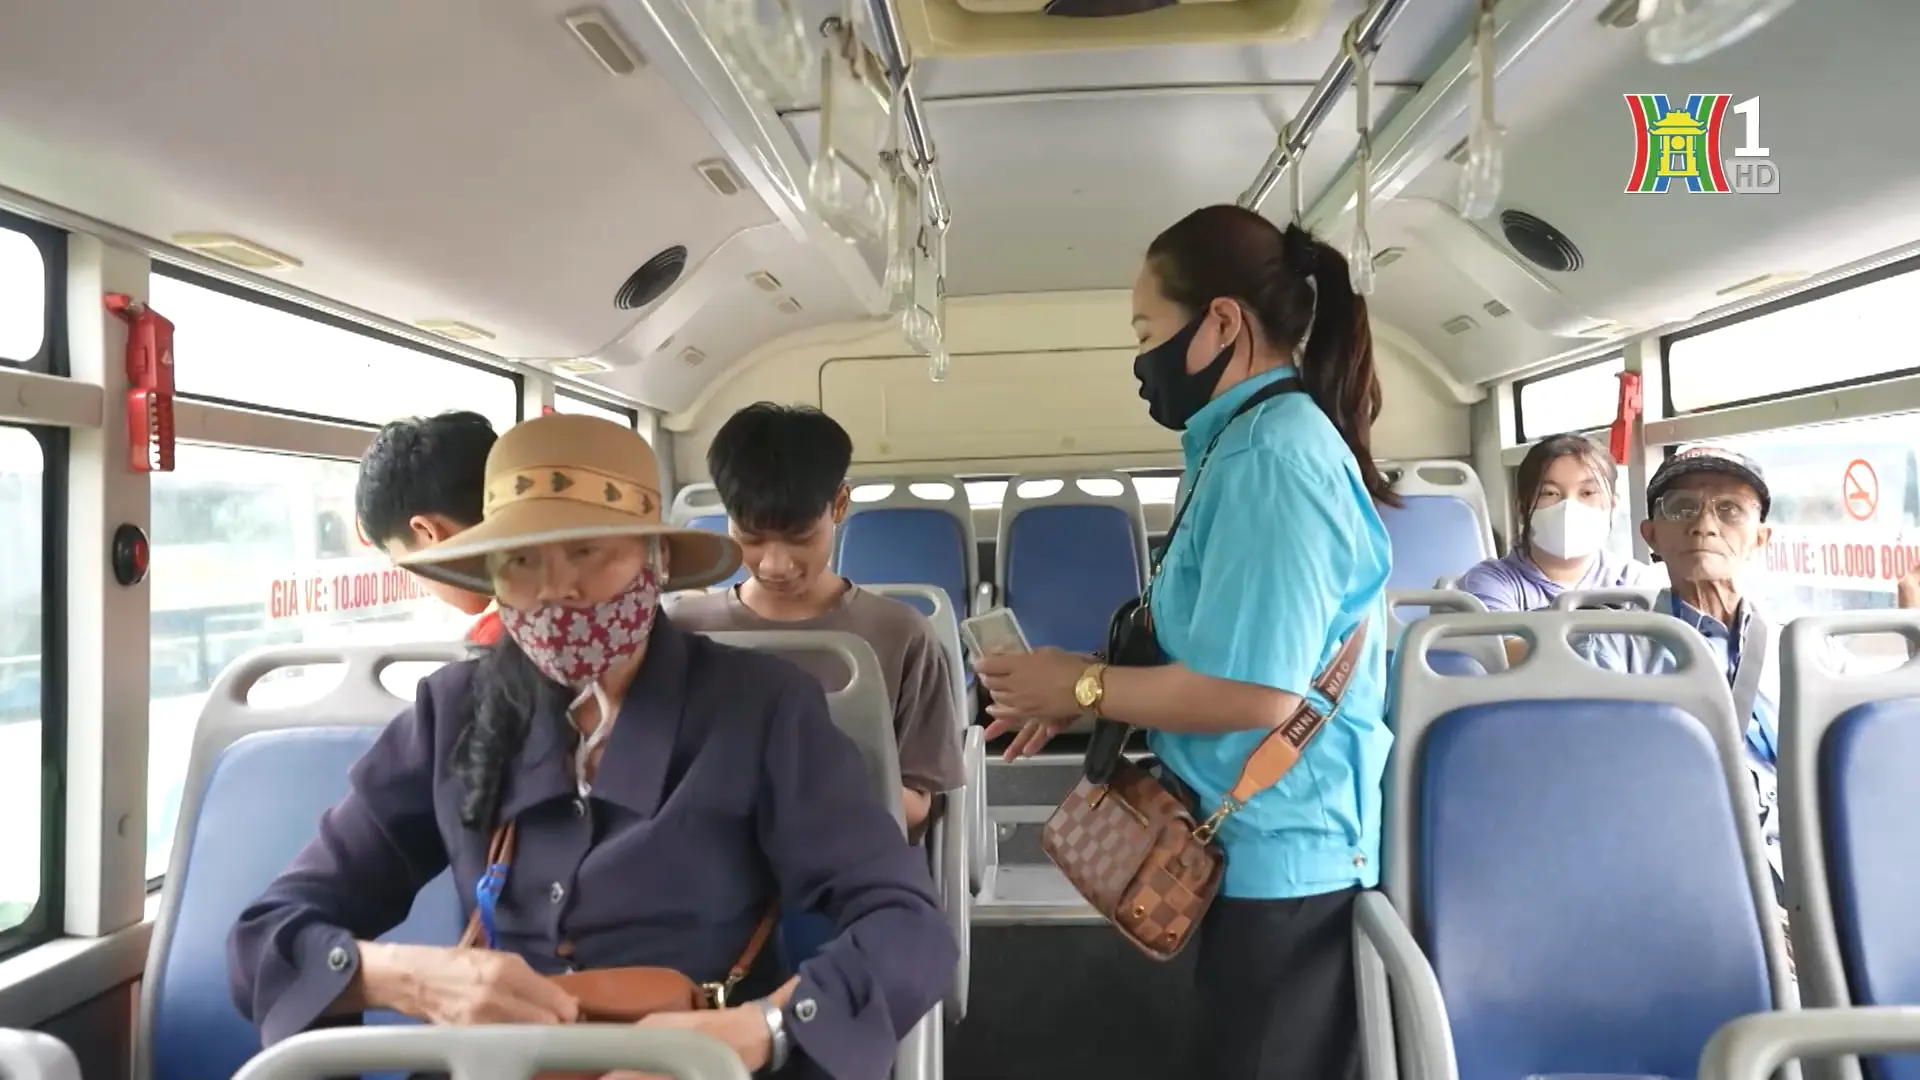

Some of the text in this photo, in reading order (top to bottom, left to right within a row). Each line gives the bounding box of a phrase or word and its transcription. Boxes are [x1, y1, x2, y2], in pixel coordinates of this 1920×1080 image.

[1821, 543, 1876, 579] 10.000
[271, 572, 299, 619] GIÁ
[332, 572, 378, 611] 10.000
